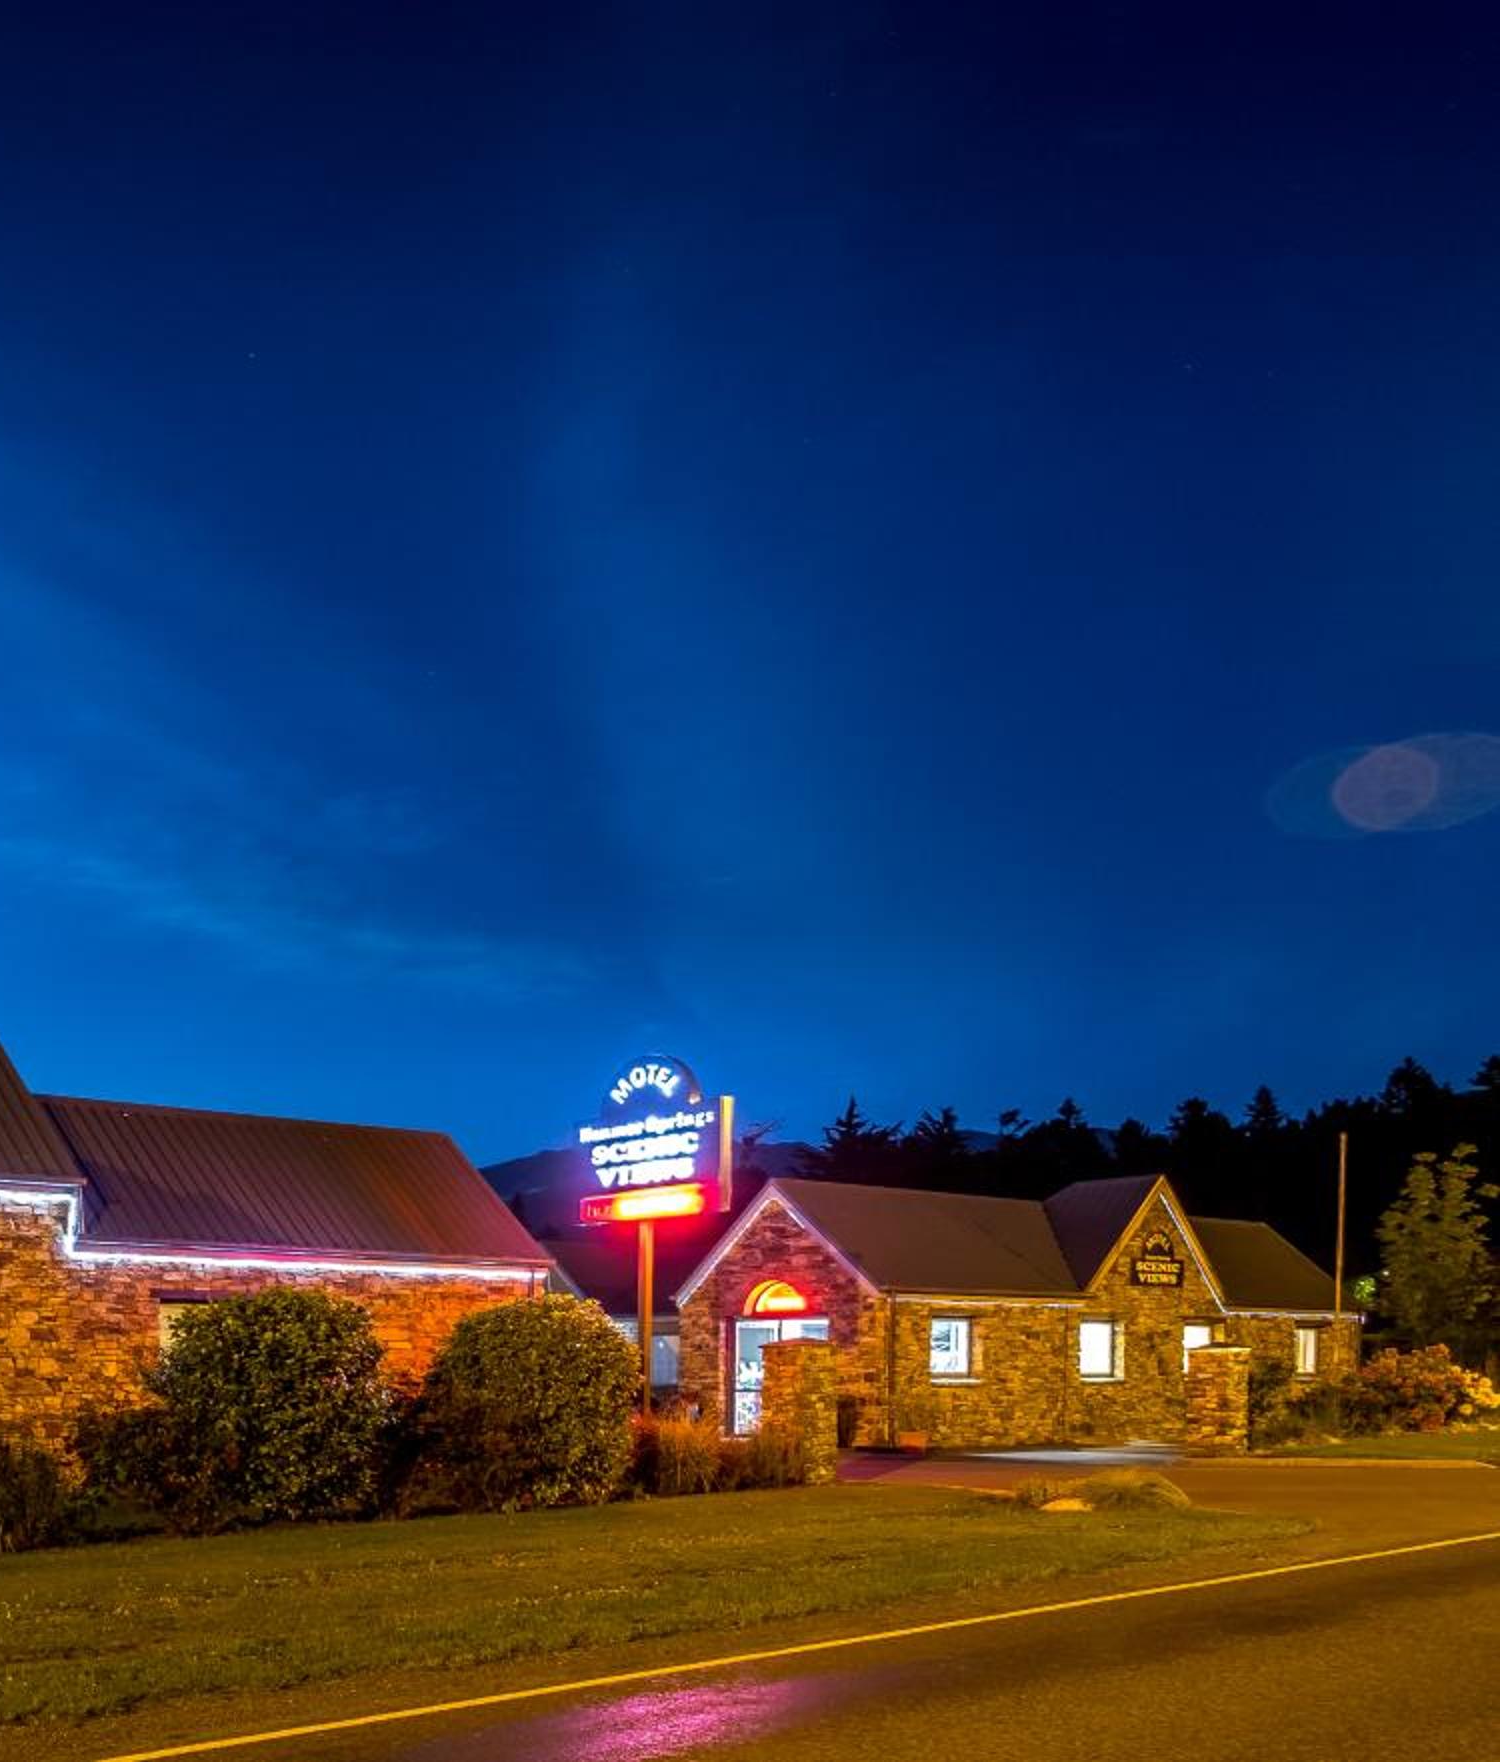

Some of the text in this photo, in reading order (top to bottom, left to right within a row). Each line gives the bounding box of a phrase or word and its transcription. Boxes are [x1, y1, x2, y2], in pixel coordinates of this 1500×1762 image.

[610, 1064, 679, 1104] MOTEL
[1136, 1261, 1180, 1273] SCENIC
[1138, 1273, 1177, 1284] VIEWS
